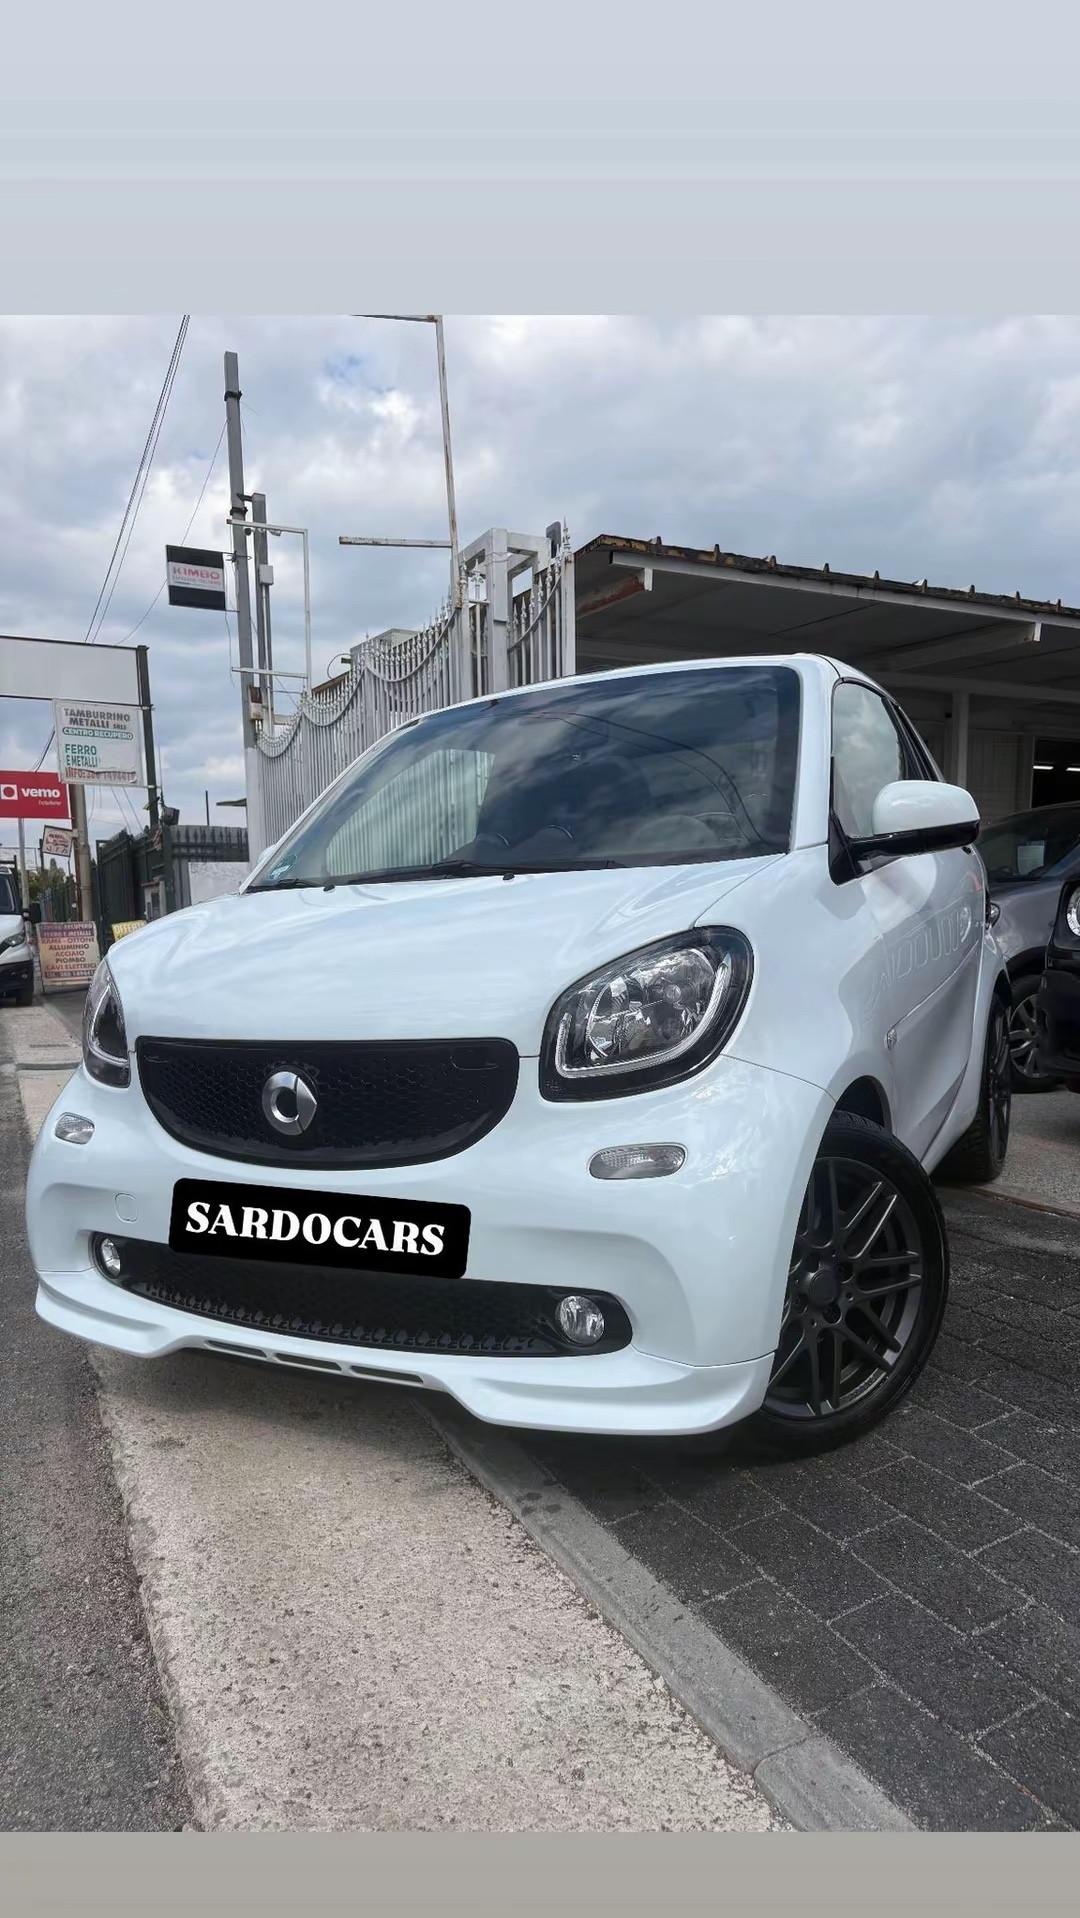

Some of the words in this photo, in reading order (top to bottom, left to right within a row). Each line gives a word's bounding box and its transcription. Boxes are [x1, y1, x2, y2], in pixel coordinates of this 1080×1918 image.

[64, 708, 130, 722] TAMBURRINO
[69, 717, 109, 729] METALLI
[63, 728, 94, 737] CENTRO
[95, 730, 133, 740] RECUPERO
[65, 744, 97, 756] FERRO
[72, 756, 98, 768] METALLI
[21, 787, 61, 799] vemo
[49, 943, 89, 951] ALLUMINIO
